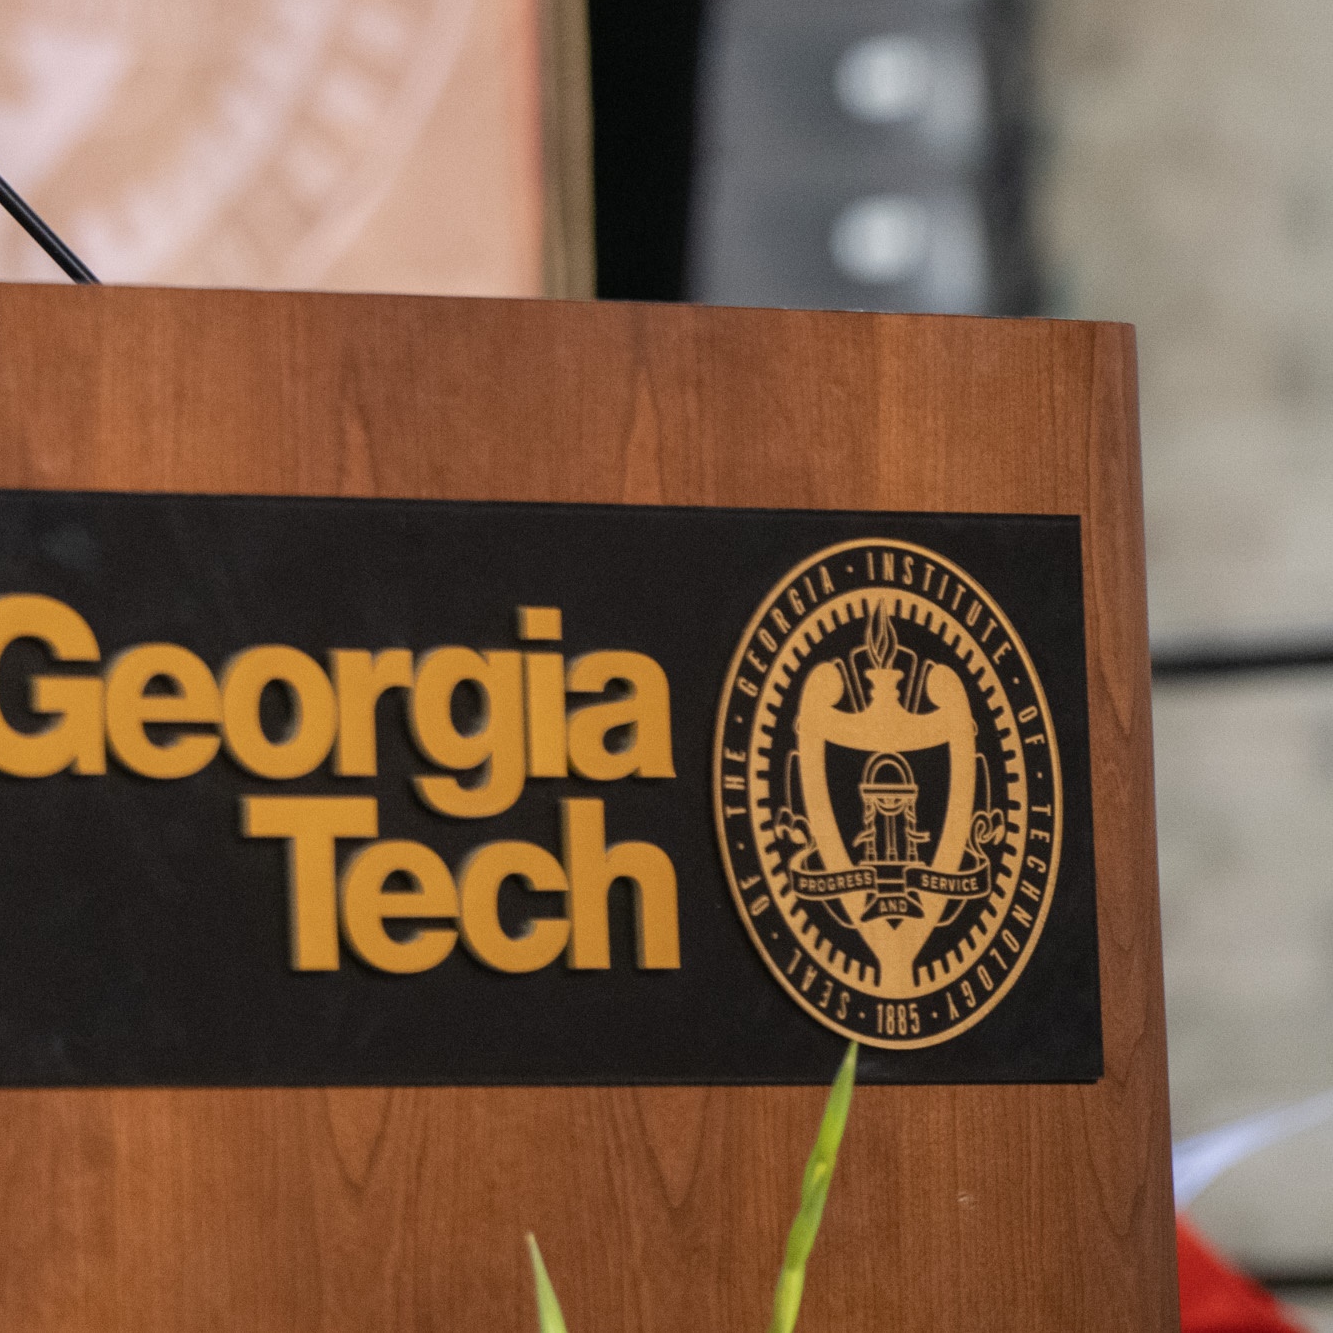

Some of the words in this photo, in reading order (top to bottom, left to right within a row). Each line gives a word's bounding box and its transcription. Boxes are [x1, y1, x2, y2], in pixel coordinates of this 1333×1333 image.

[734, 565, 837, 698] GEORGIA
[865, 551, 1013, 665] INSTITUTE
[1017, 705, 1046, 747] OF
[722, 747, 748, 820] THE
[240, 795, 681, 974] Tech
[740, 872, 770, 918] OF
[798, 872, 875, 892] PROGRESS
[920, 875, 979, 892] SERVICE
[879, 898, 908, 913] AND
[945, 802, 1053, 1022] TECHNOLOGY
[784, 947, 852, 1021] SEAL
[876, 1003, 921, 1035] 1885
